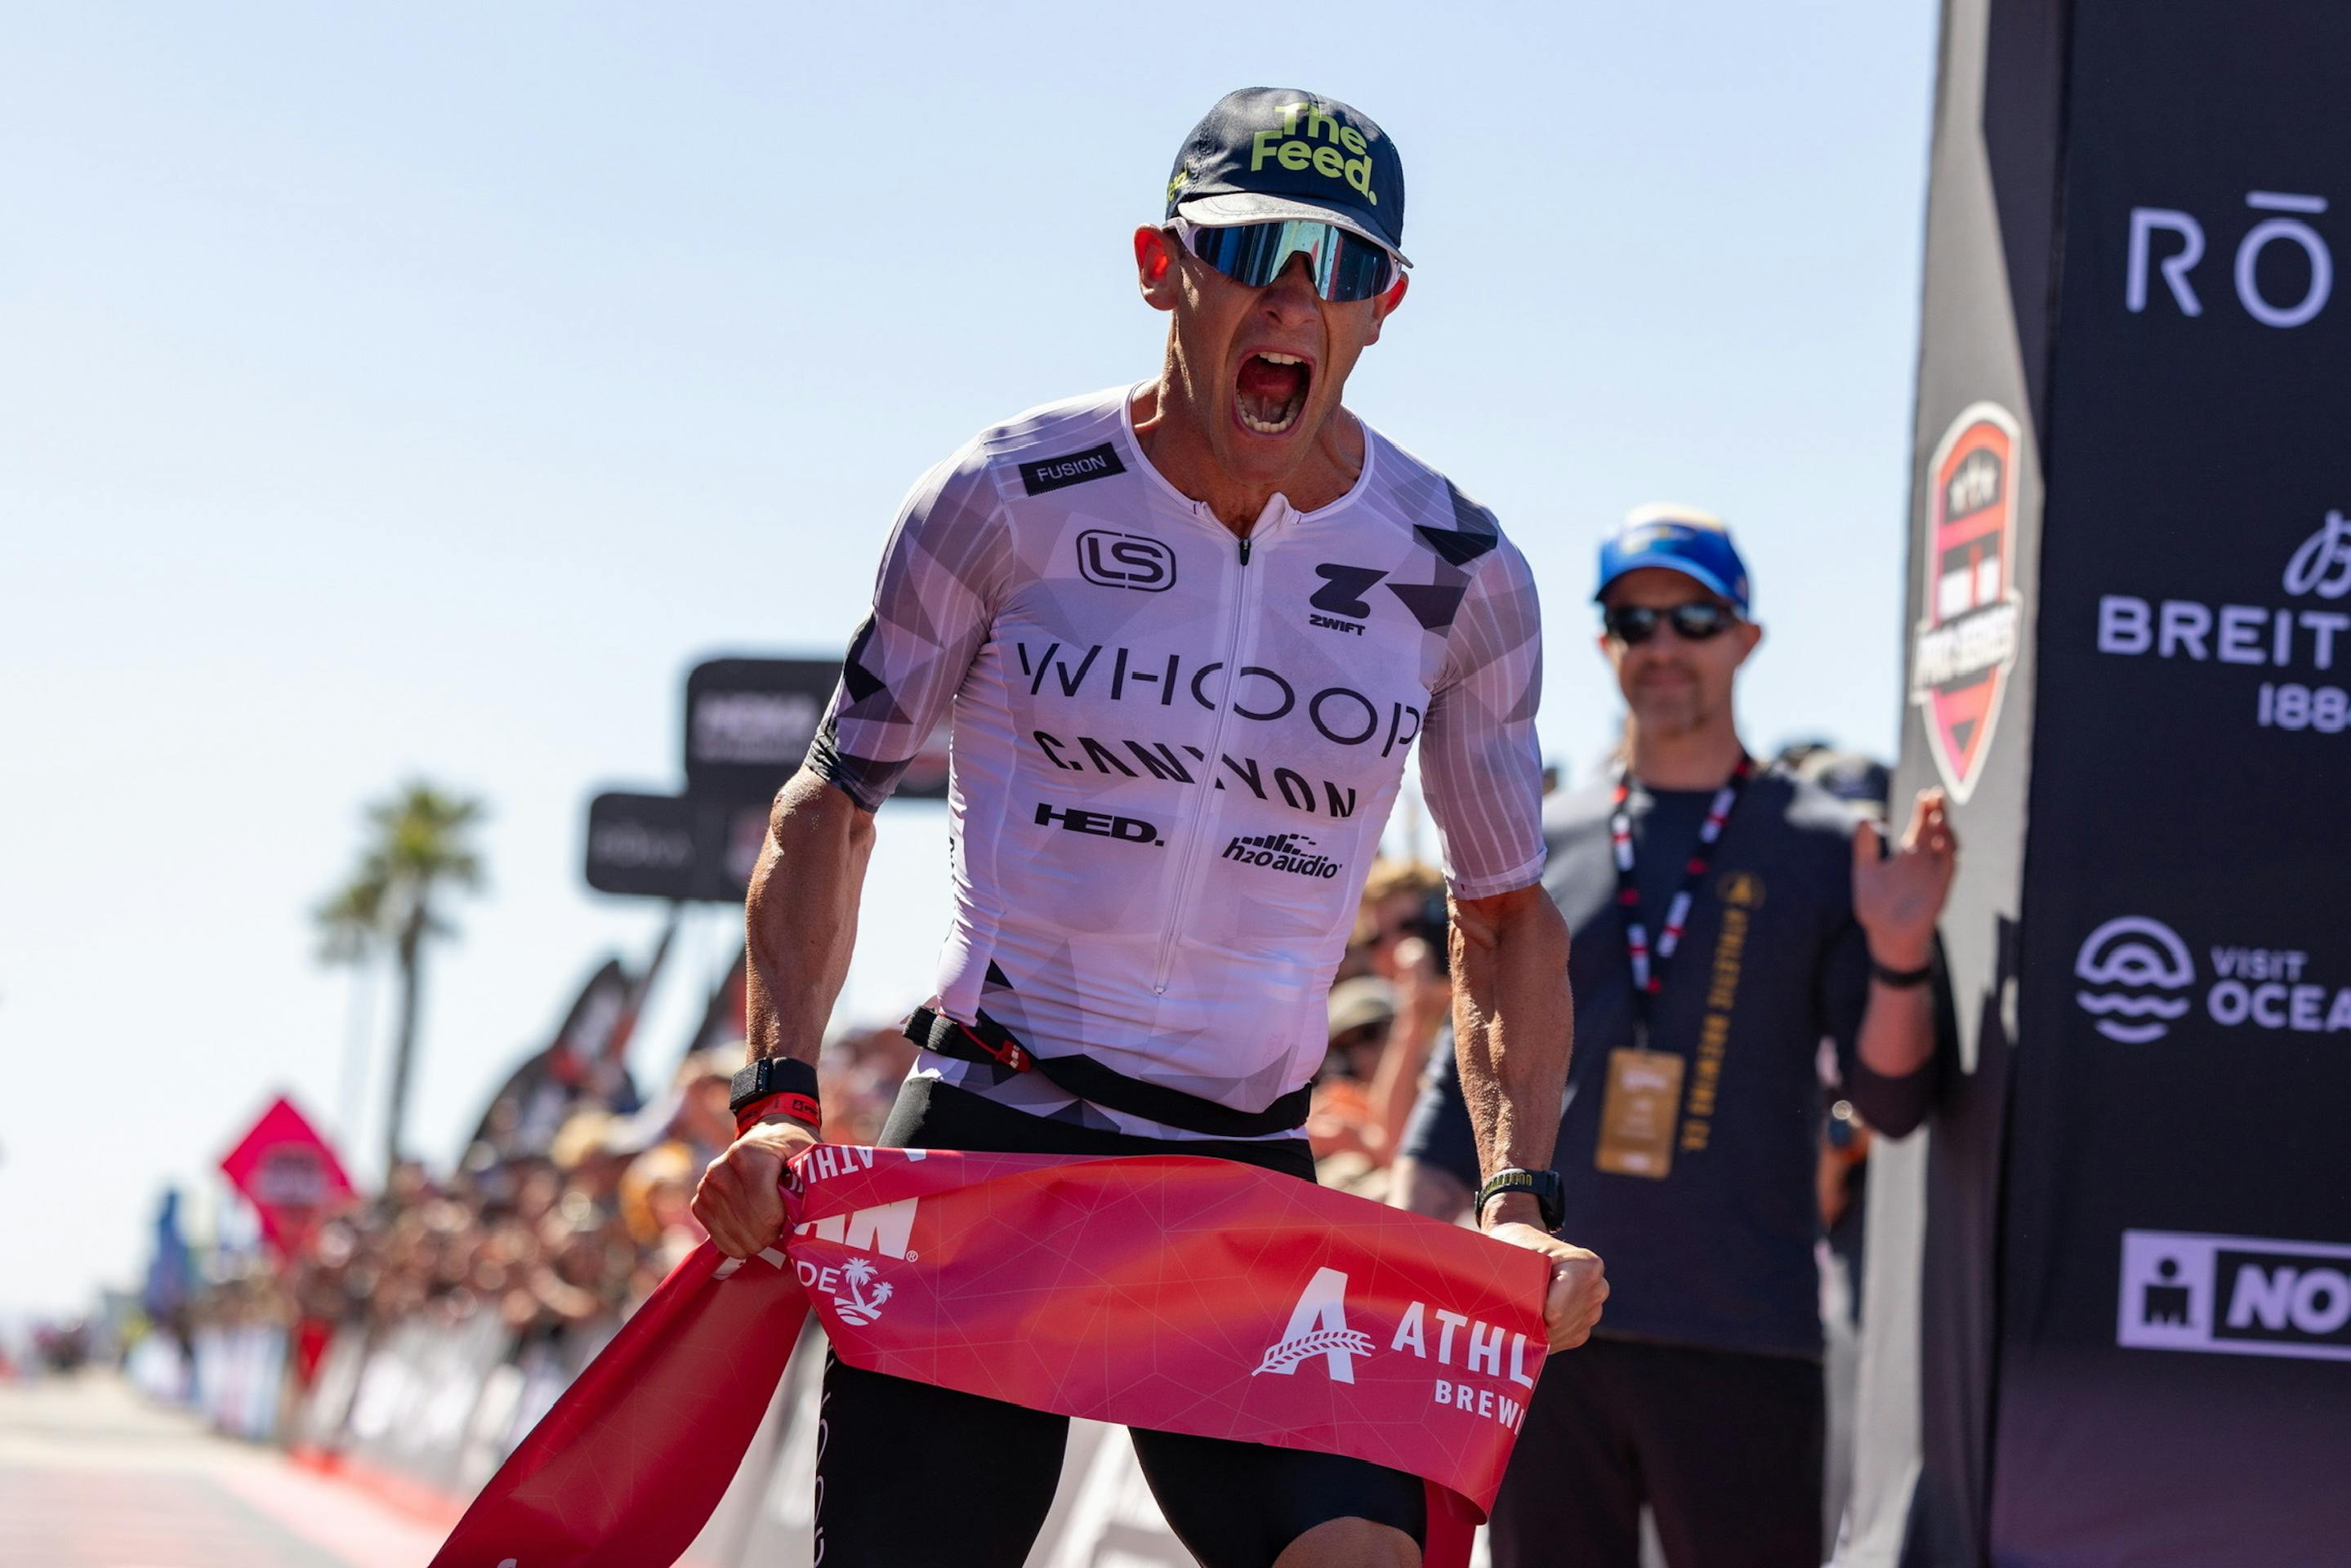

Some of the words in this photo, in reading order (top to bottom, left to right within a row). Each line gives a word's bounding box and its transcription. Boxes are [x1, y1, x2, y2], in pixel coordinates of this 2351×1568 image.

[1274, 102, 1368, 155] The
[1251, 130, 1377, 206] Feed.
[1037, 455, 1107, 483] FUSION
[1309, 614, 1366, 636] ZWIFT
[1016, 642, 1421, 759] WHOOP
[1033, 730, 1357, 817] CANYON
[1034, 803, 1165, 847] HED.
[2209, 945, 2309, 982] VISIT
[1390, 1301, 1534, 1390] ATHL
